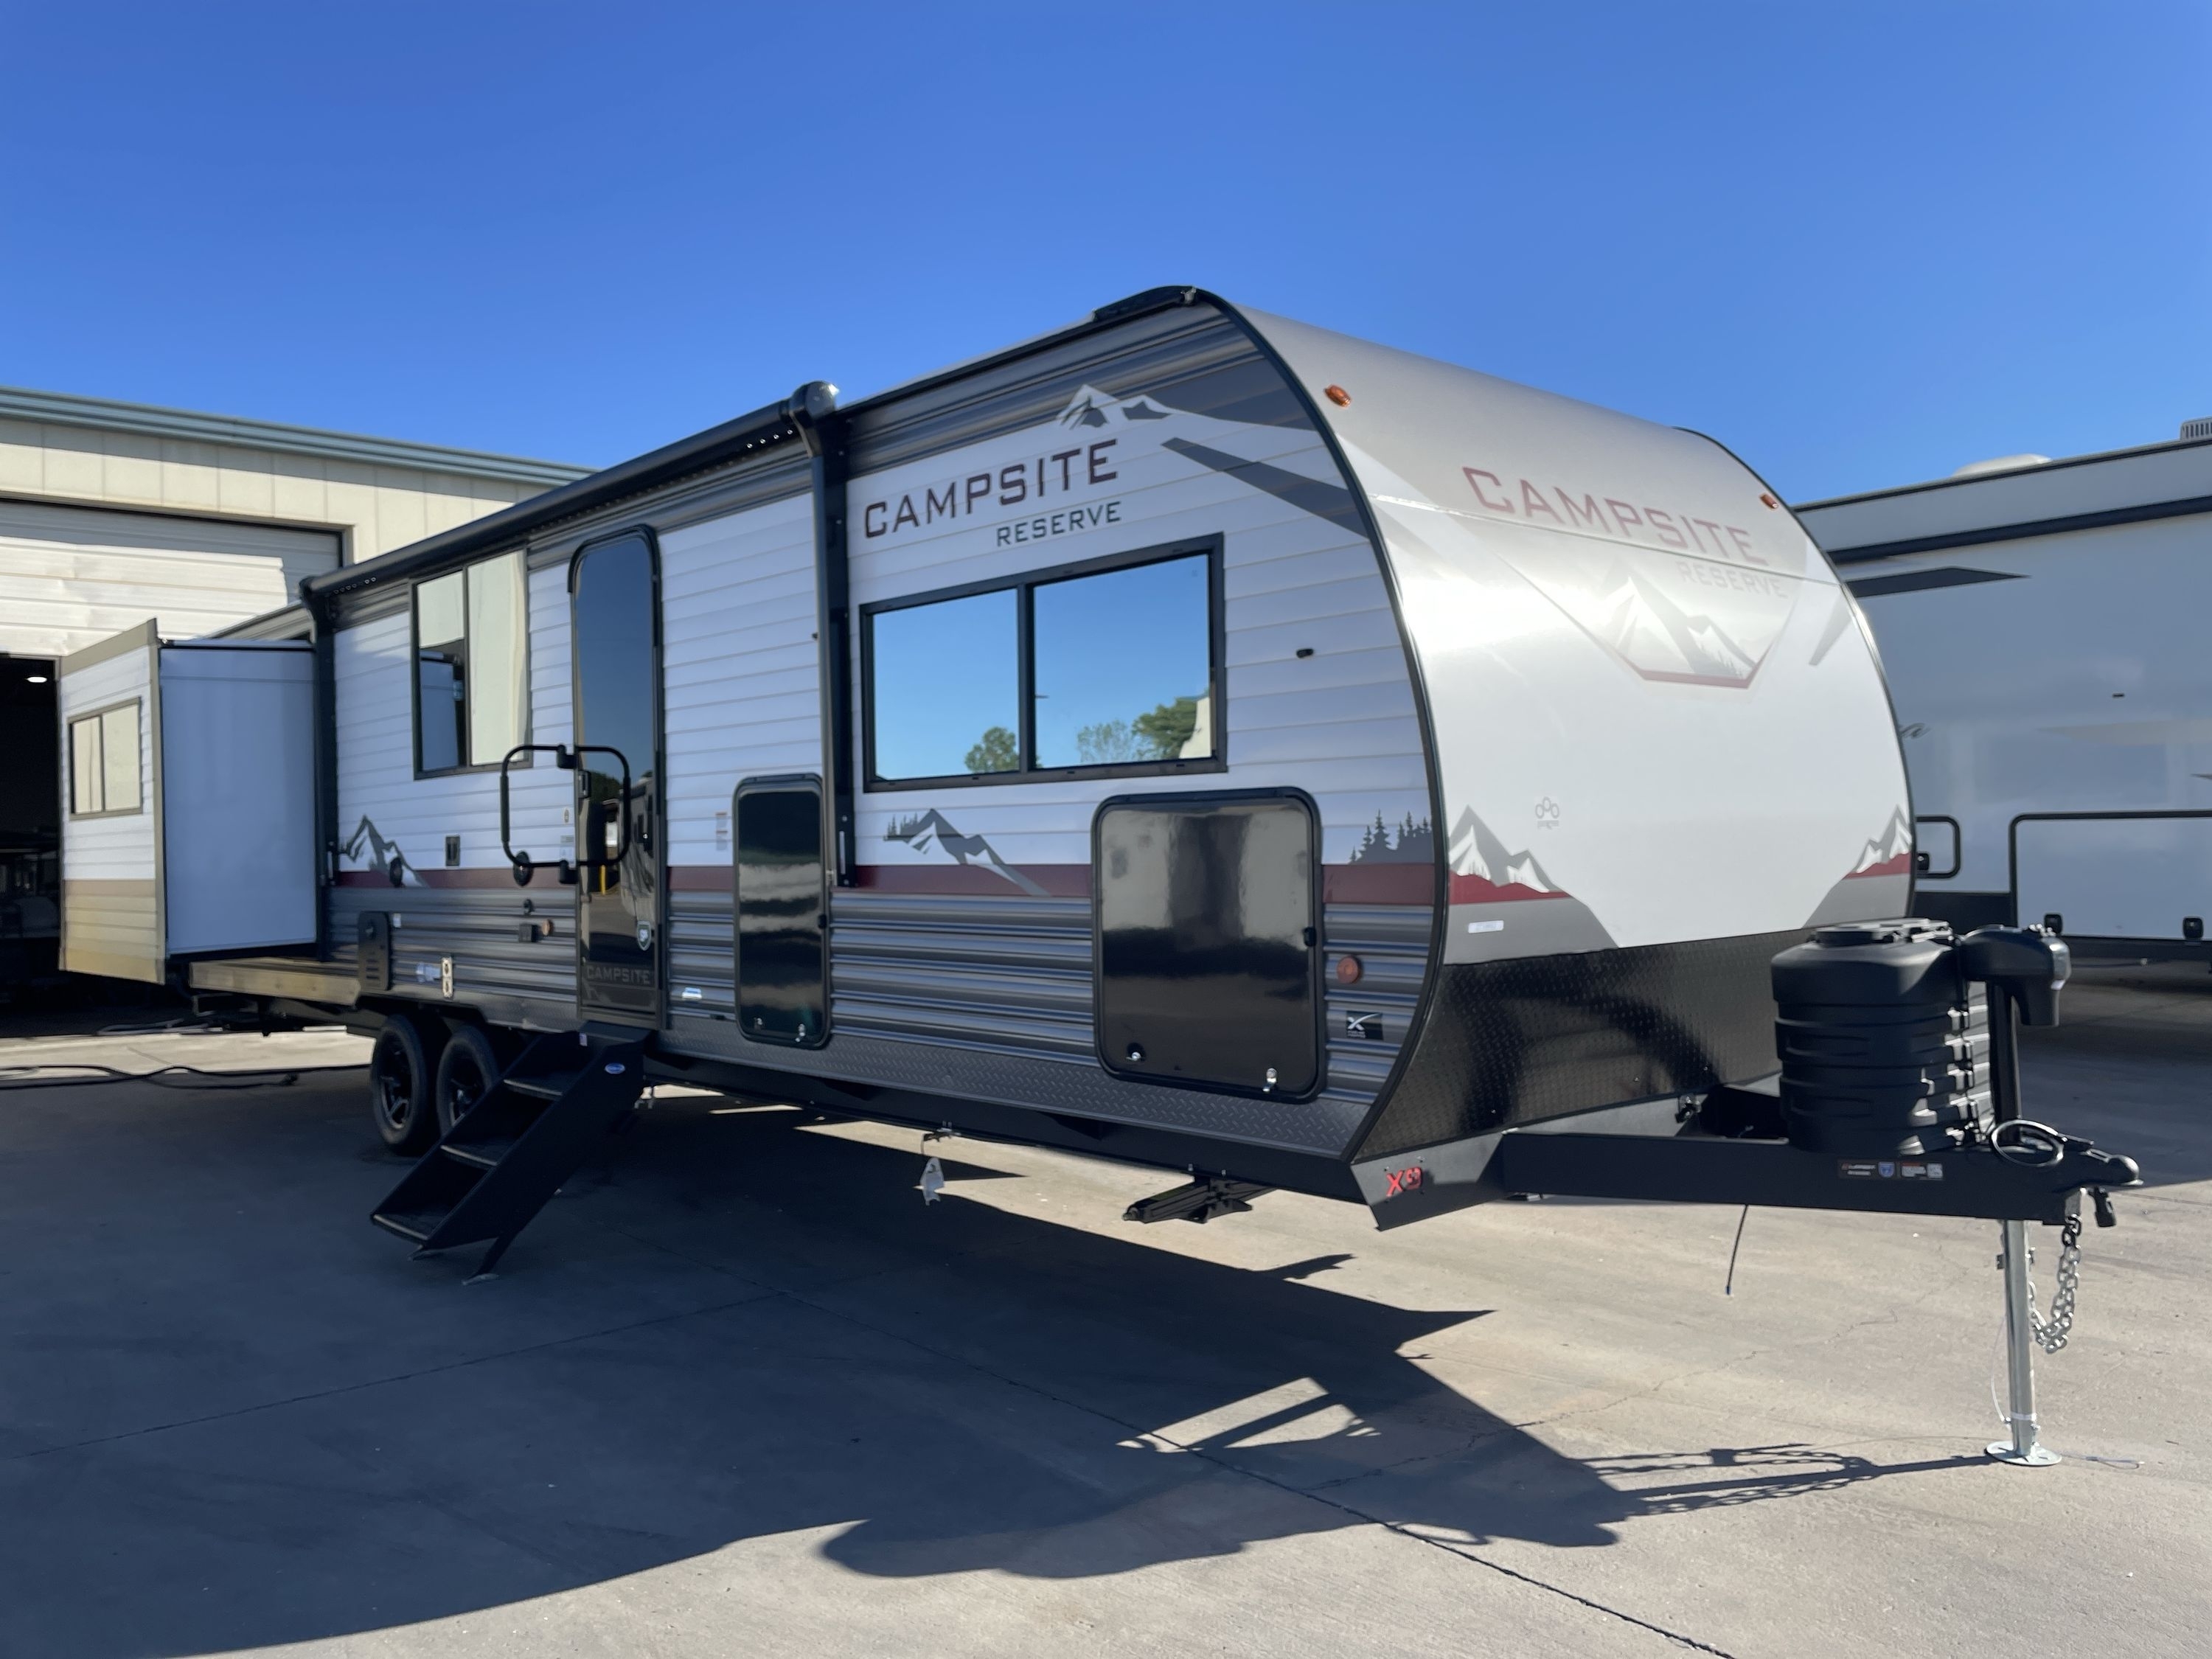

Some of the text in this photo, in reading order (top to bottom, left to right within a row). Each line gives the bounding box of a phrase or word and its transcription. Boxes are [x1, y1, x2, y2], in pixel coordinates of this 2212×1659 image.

[864, 438, 1119, 539] CAMPSITE
[997, 501, 1121, 548] RESERVE
[1461, 466, 1769, 566] CAMPSITE
[1675, 560, 1789, 599] RESERVE
[586, 964, 651, 985] CAMPSITE
